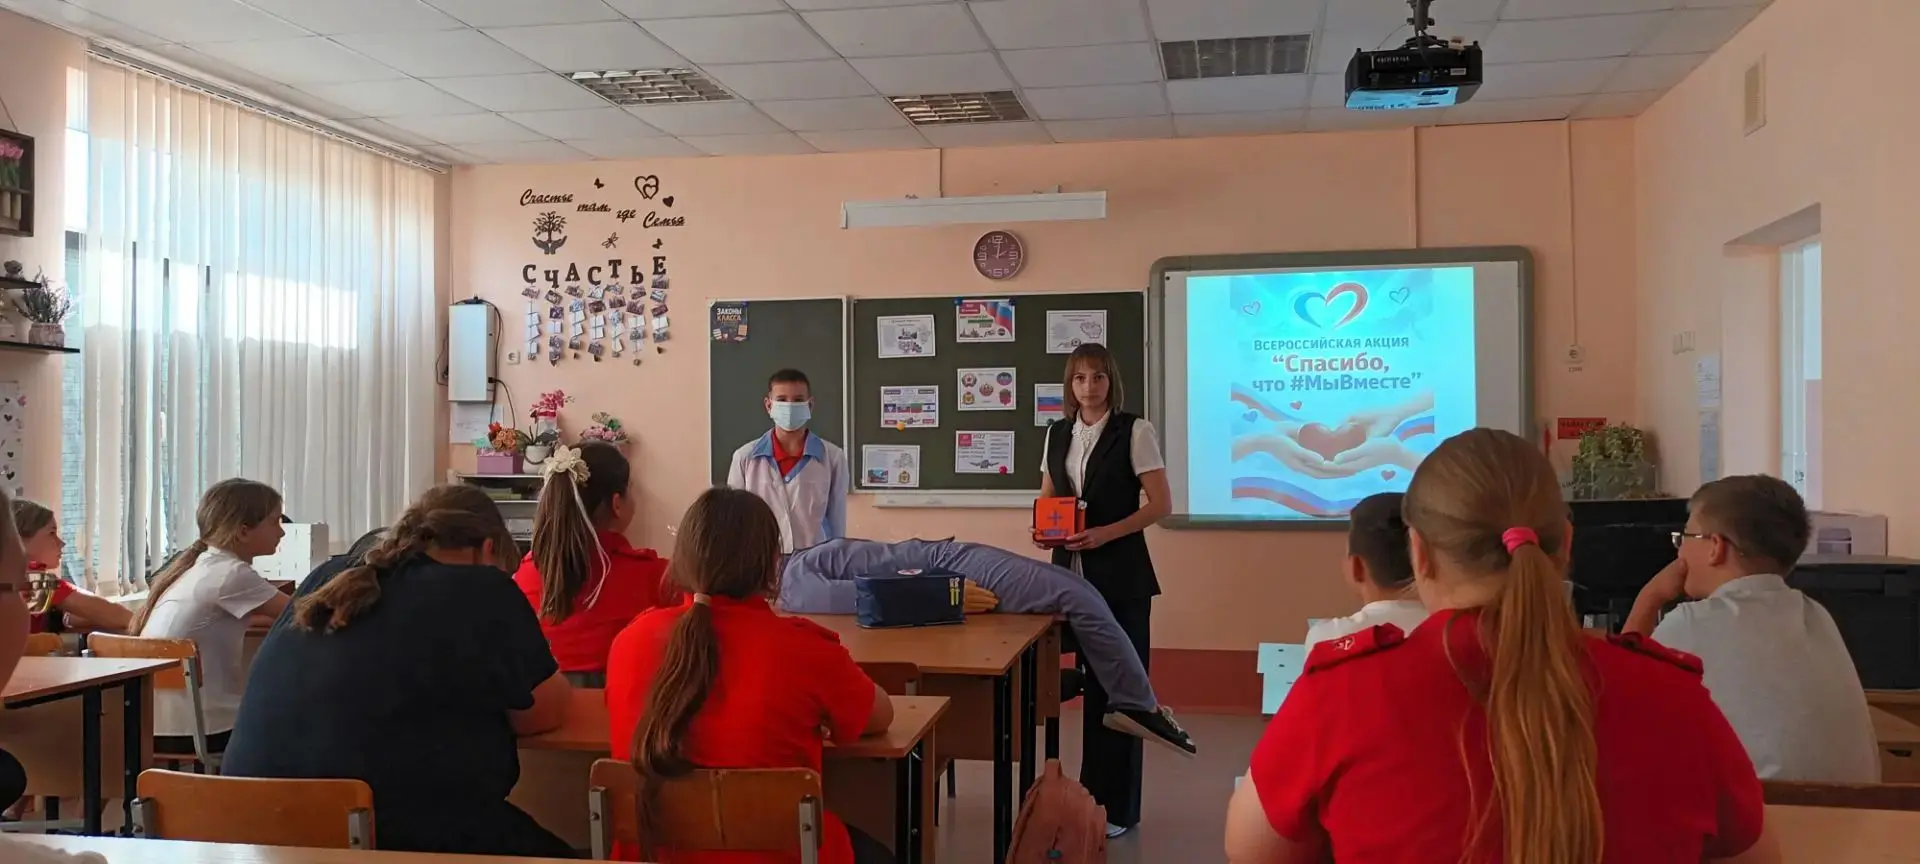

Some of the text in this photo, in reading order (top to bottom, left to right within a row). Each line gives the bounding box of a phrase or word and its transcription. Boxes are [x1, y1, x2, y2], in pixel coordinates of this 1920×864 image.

[520, 189, 573, 206] Счастье
[616, 208, 637, 223] где
[643, 211, 685, 228] Семья
[523, 256, 667, 289] СЧАСТЬЕ
[1253, 337, 1409, 351] ВСЕРОССИЙСКАЯ АКЦИЯ
[1252, 379, 1285, 393] что
